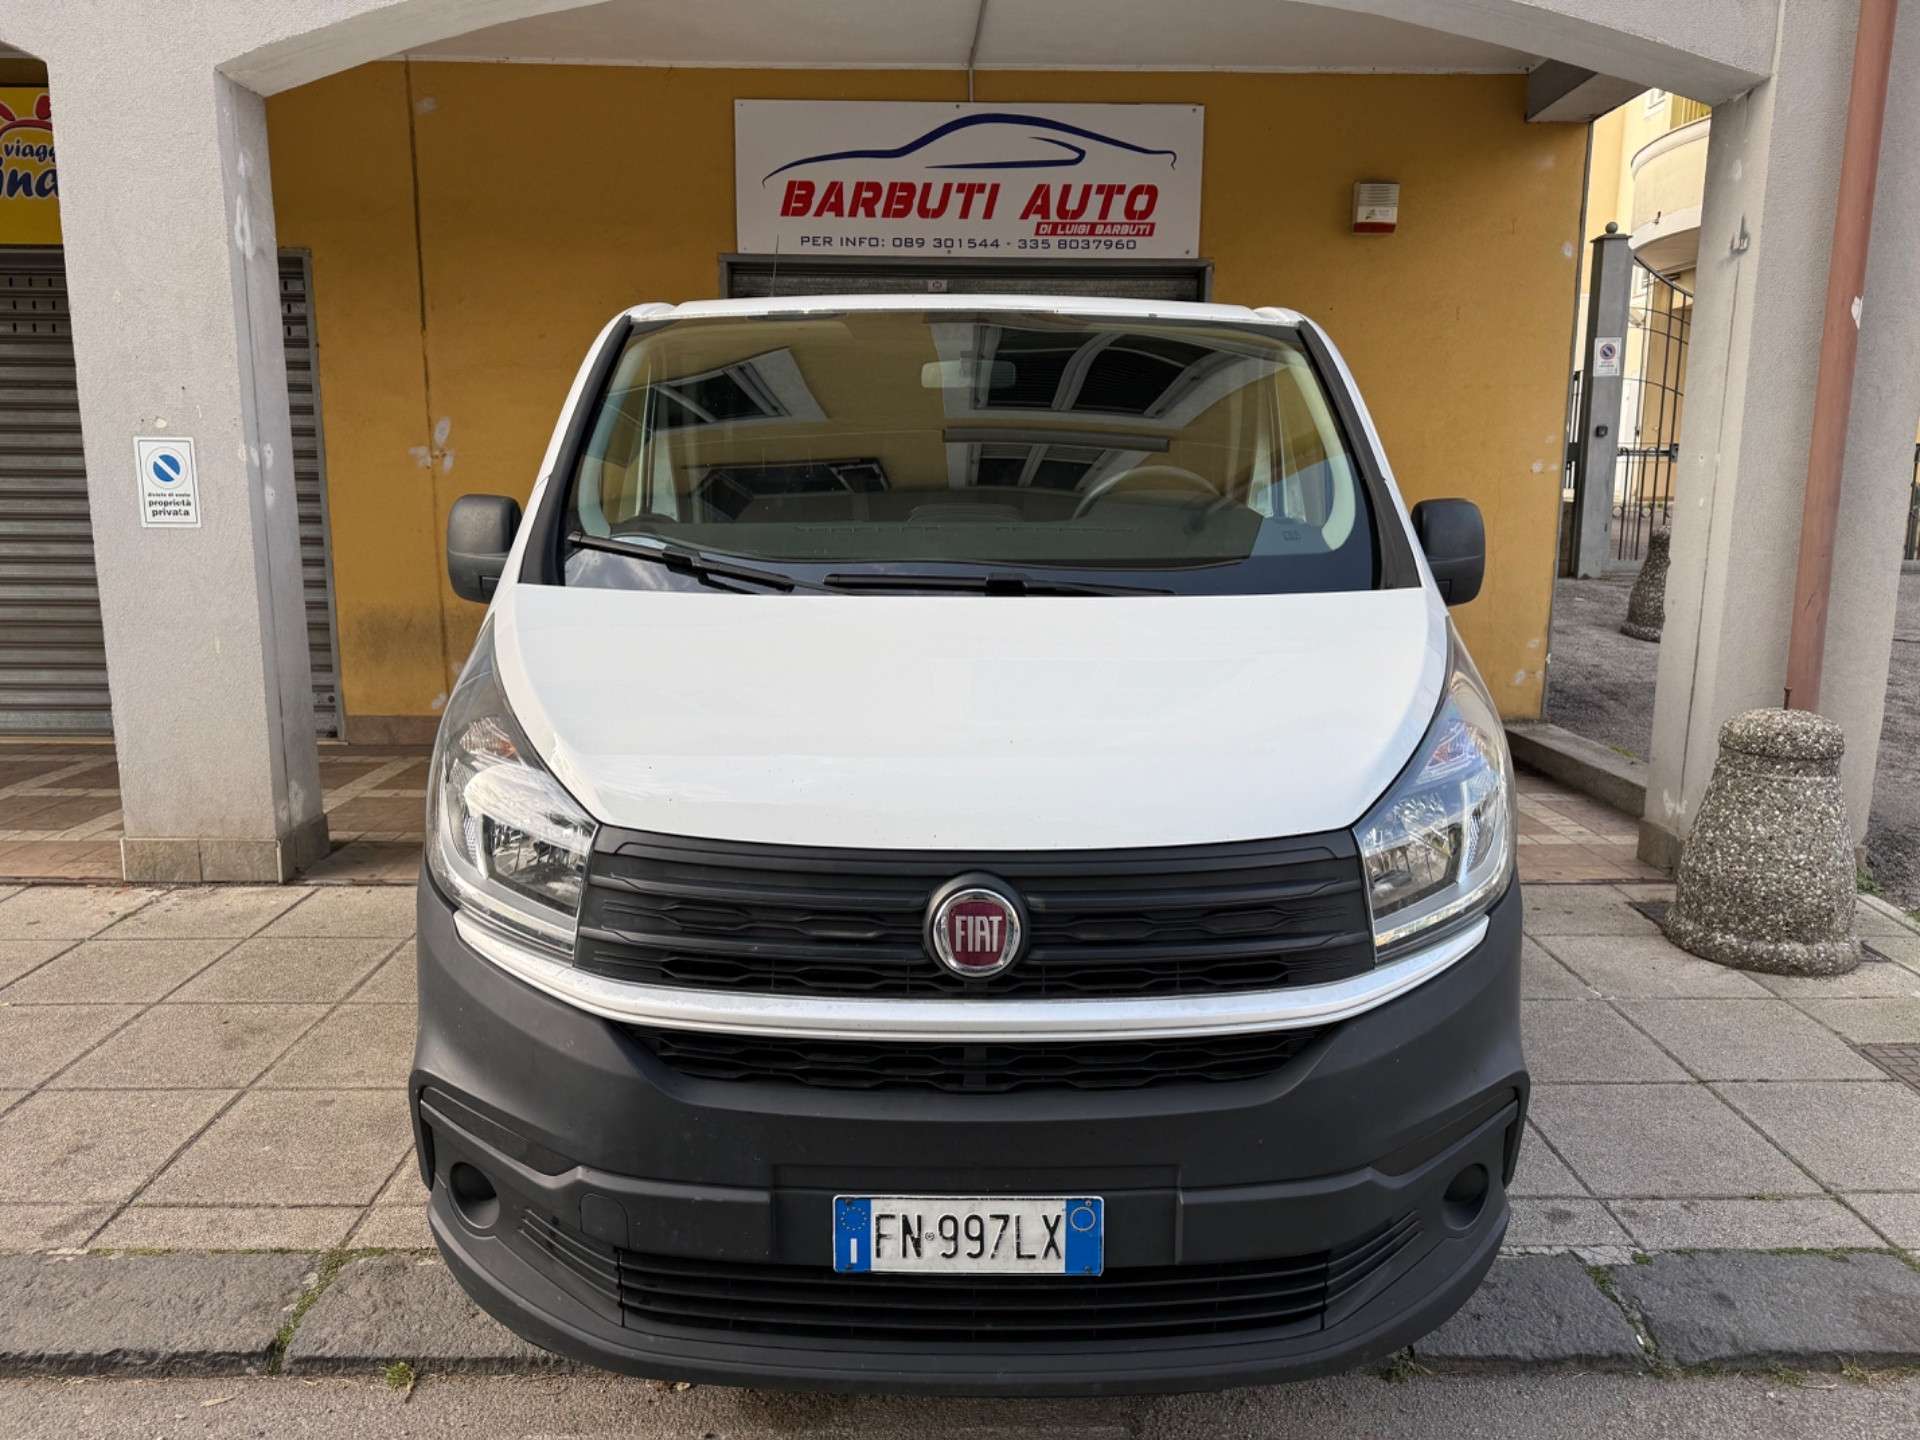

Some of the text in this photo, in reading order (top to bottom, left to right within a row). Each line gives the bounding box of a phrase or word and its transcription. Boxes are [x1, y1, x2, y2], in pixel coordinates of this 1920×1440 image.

[780, 180, 1159, 220] BARBUTI AUTO
[1039, 224, 1150, 235] DI LUIGI BARBUTI
[800, 236, 1137, 250] PER INFO: 089 301544 335 8037960
[152, 508, 190, 517] privata
[955, 915, 1002, 953] FIAT
[874, 1214, 923, 1259] FN
[937, 1214, 1062, 1260] 997LX
